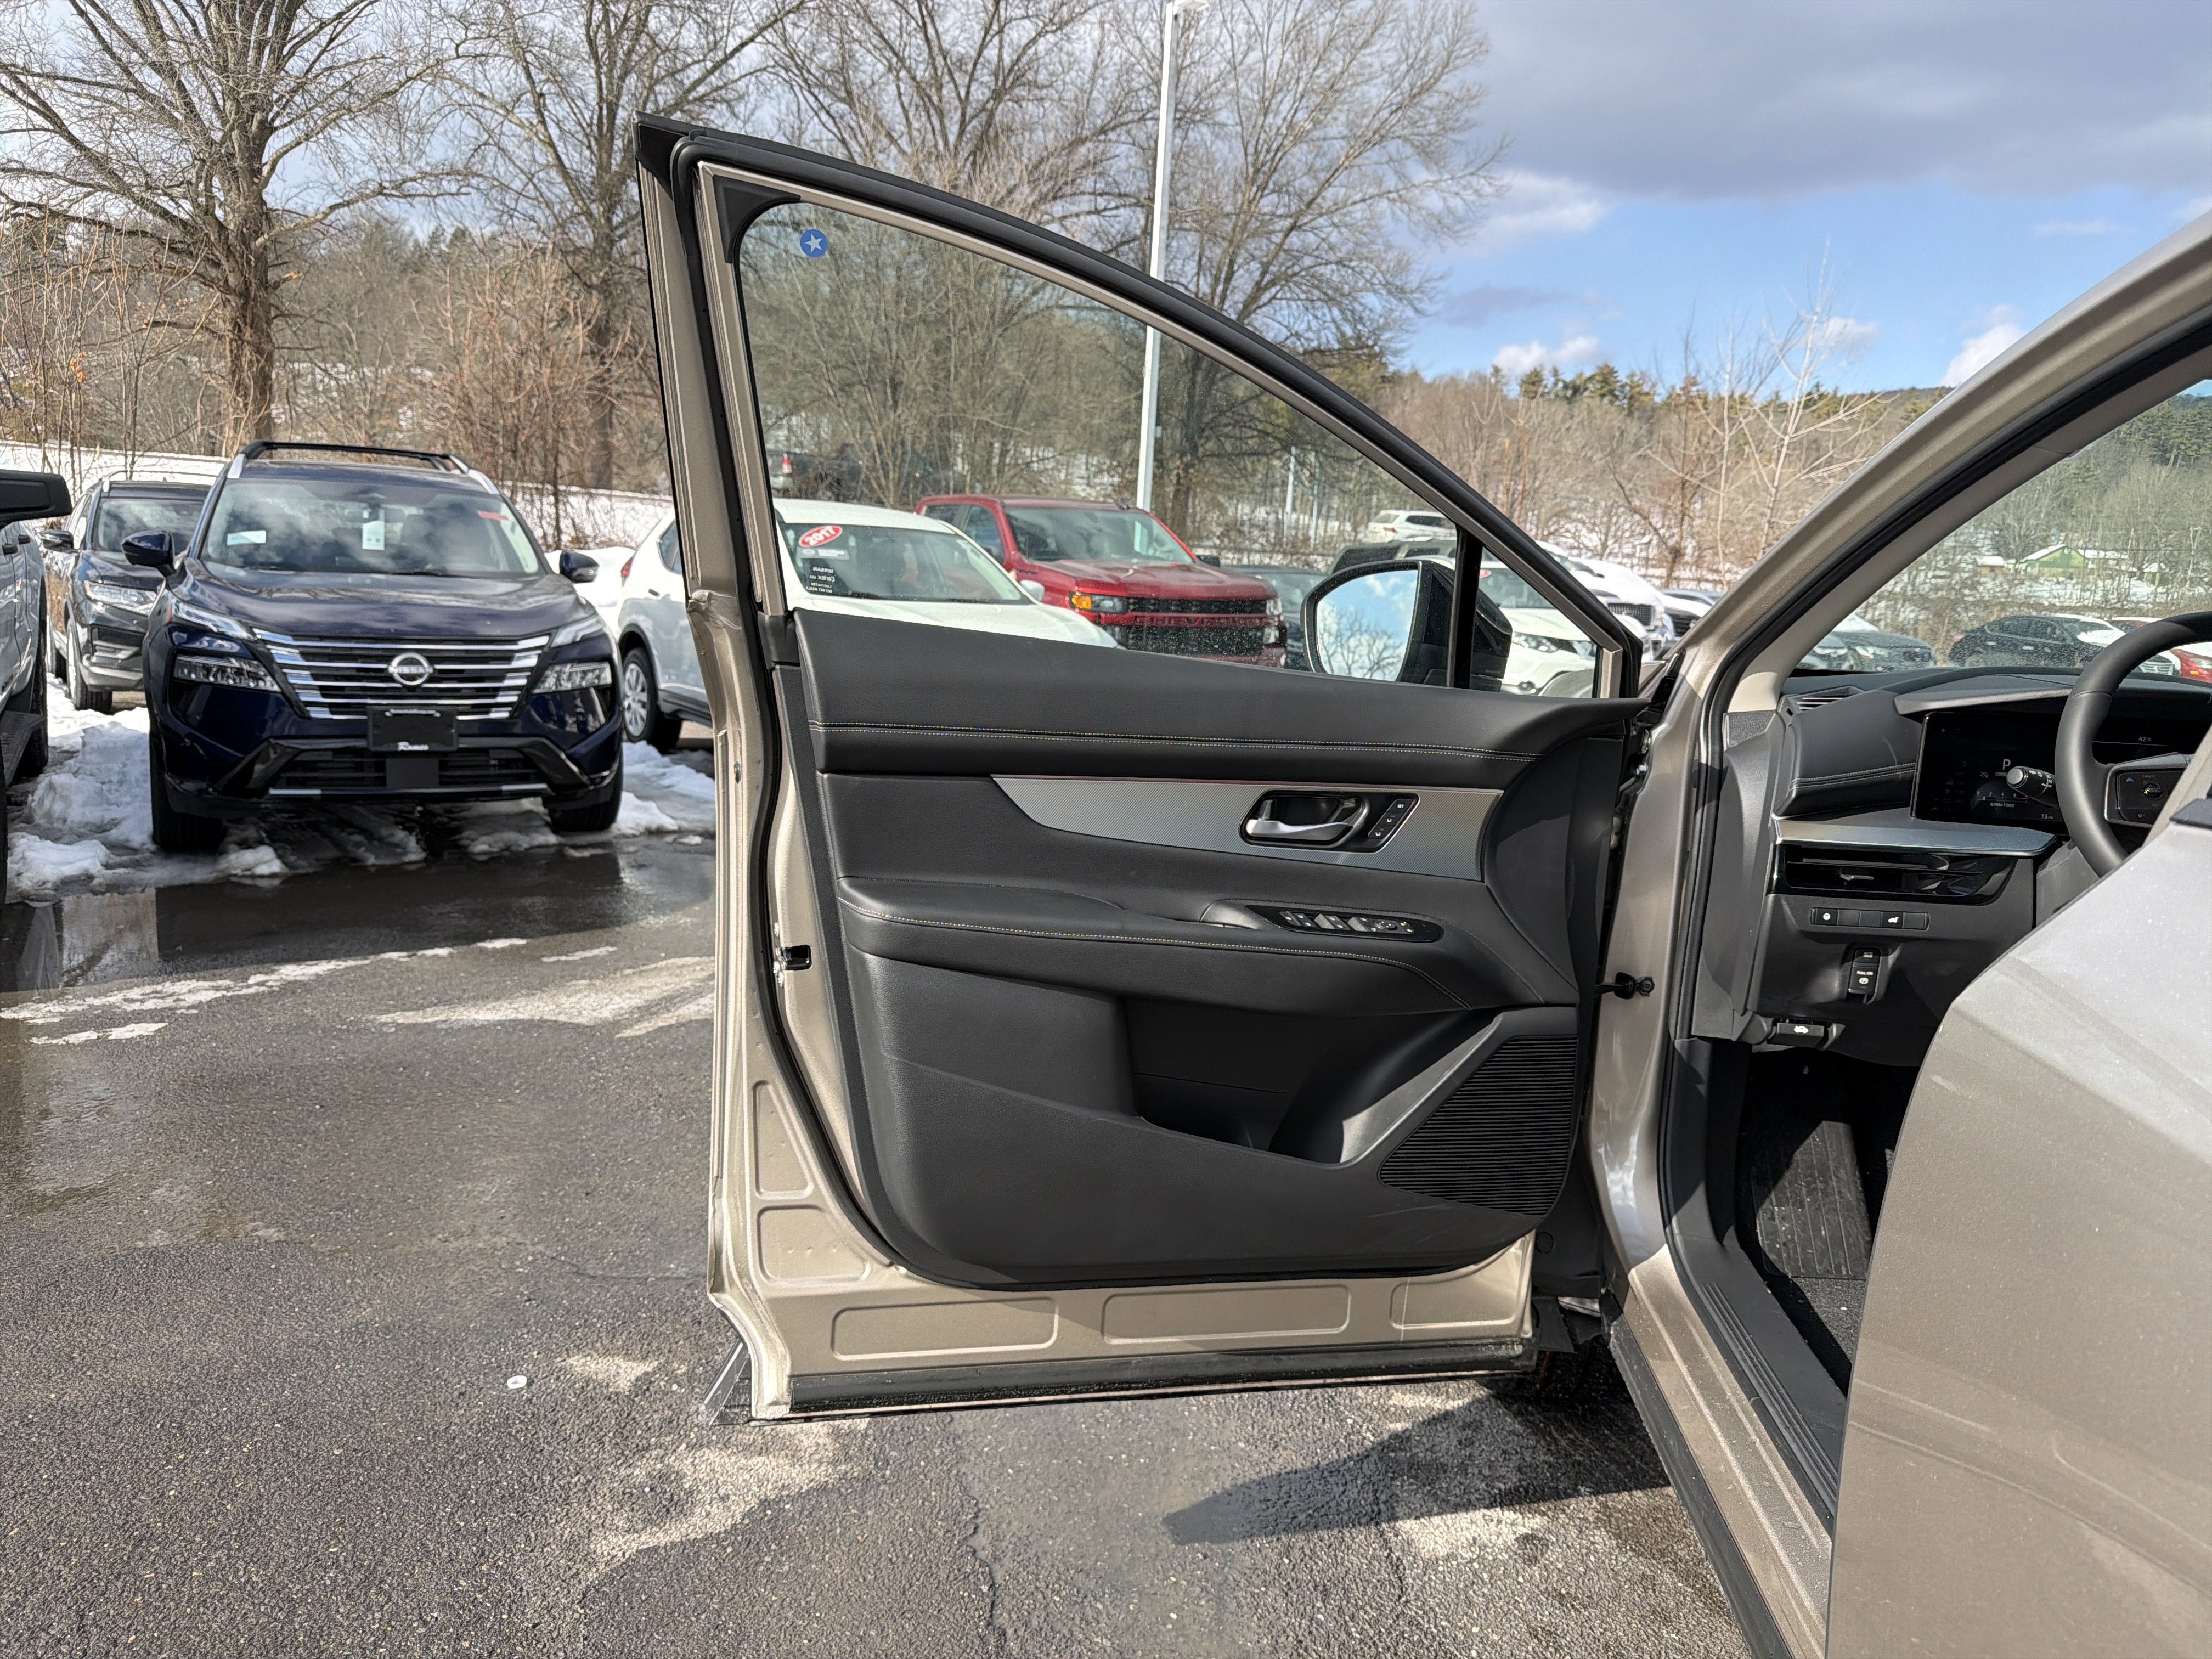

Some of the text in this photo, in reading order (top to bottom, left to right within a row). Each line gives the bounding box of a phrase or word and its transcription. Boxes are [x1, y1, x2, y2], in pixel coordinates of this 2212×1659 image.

[804, 526, 835, 545] 2017
[388, 665, 433, 674] NISSAN
[2002, 759, 2011, 770] P
